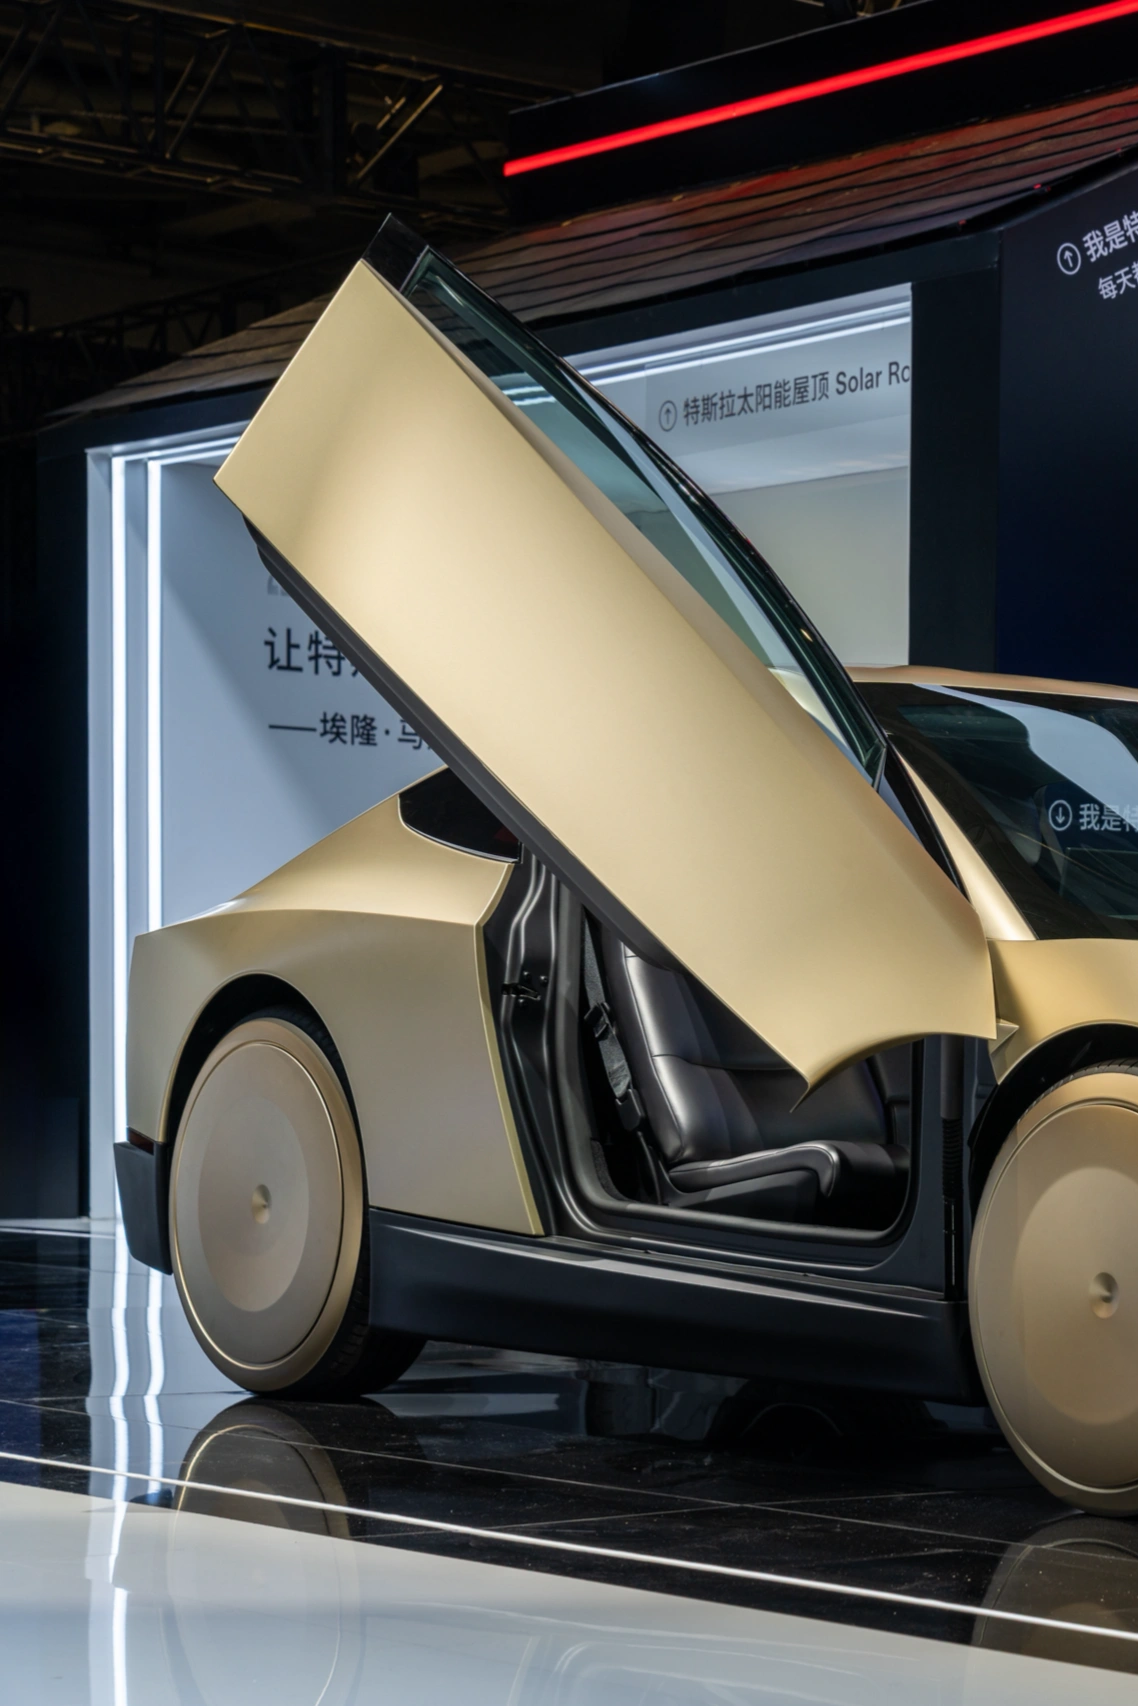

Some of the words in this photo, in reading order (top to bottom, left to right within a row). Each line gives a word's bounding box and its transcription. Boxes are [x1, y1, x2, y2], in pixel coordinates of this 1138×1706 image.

[683, 371, 829, 426] 特斯拉太阳能屋顶
[836, 366, 882, 395] Solar
[264, 626, 358, 677] 让特
[268, 711, 432, 751] ——埃隆·马
